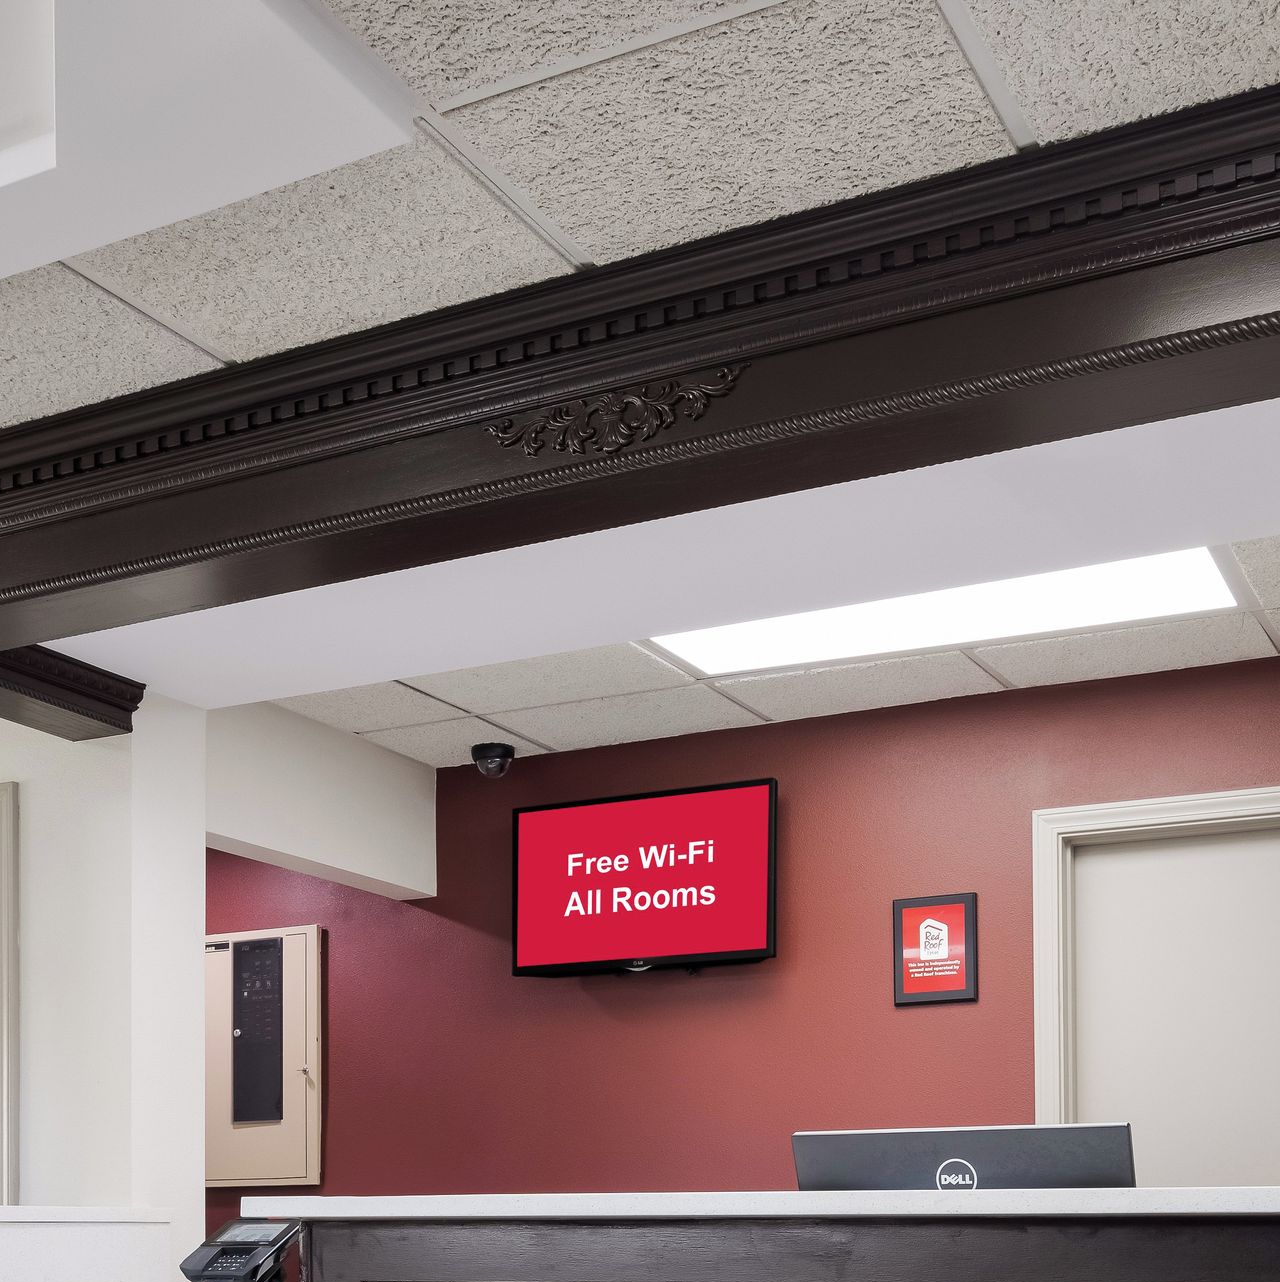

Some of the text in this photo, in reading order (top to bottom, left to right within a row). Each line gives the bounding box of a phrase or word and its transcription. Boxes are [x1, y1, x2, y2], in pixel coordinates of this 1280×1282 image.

[567, 840, 714, 876] Free Wi-Fi
[564, 884, 716, 917] All Rooms
[925, 931, 940, 941] Red
[924, 939, 944, 951] Roof
[941, 1174, 973, 1185] DELL
